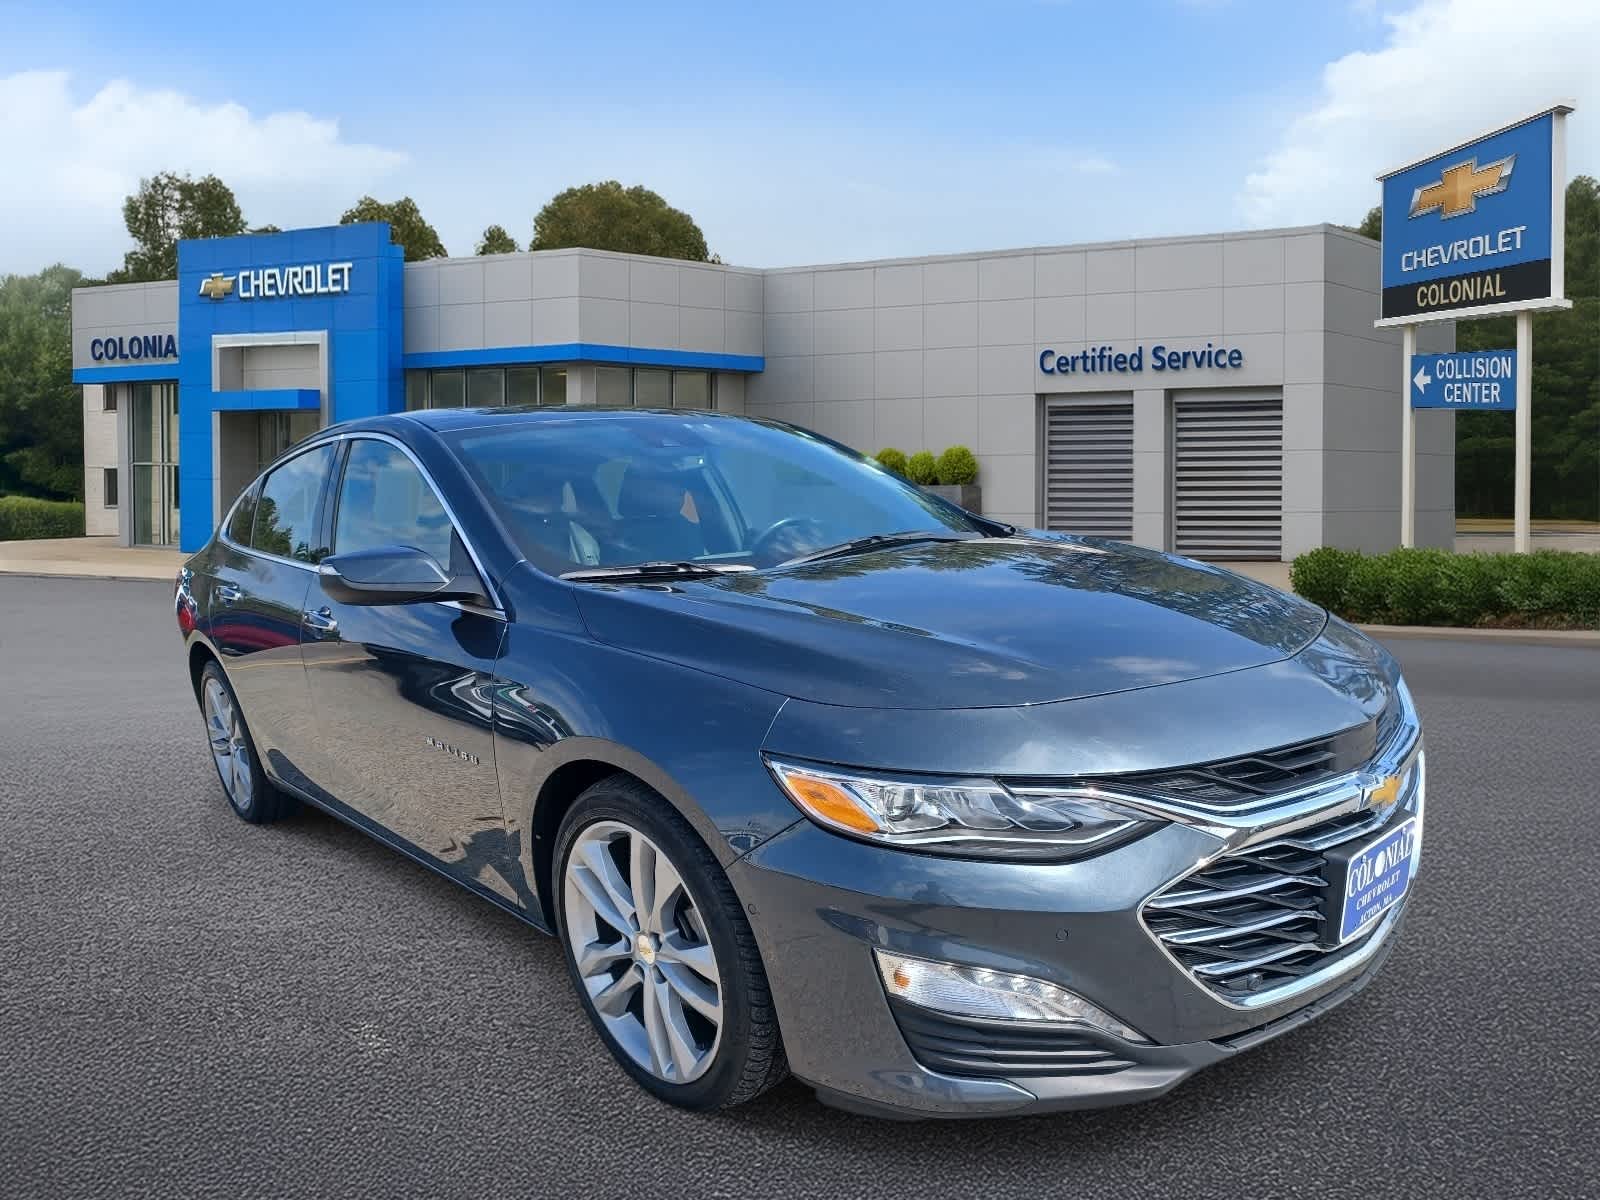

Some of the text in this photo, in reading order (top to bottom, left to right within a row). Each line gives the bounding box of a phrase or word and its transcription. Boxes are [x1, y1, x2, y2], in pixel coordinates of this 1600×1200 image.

[1401, 225, 1527, 272] CHEVROLET
[238, 262, 353, 298] CHEVROLET
[1416, 274, 1506, 307] COLONIAL
[1039, 343, 1243, 374] Certified Service
[1436, 356, 1512, 379] COLLISION
[1444, 381, 1501, 403] CENTER
[1356, 869, 1401, 911] CHEVROLET
